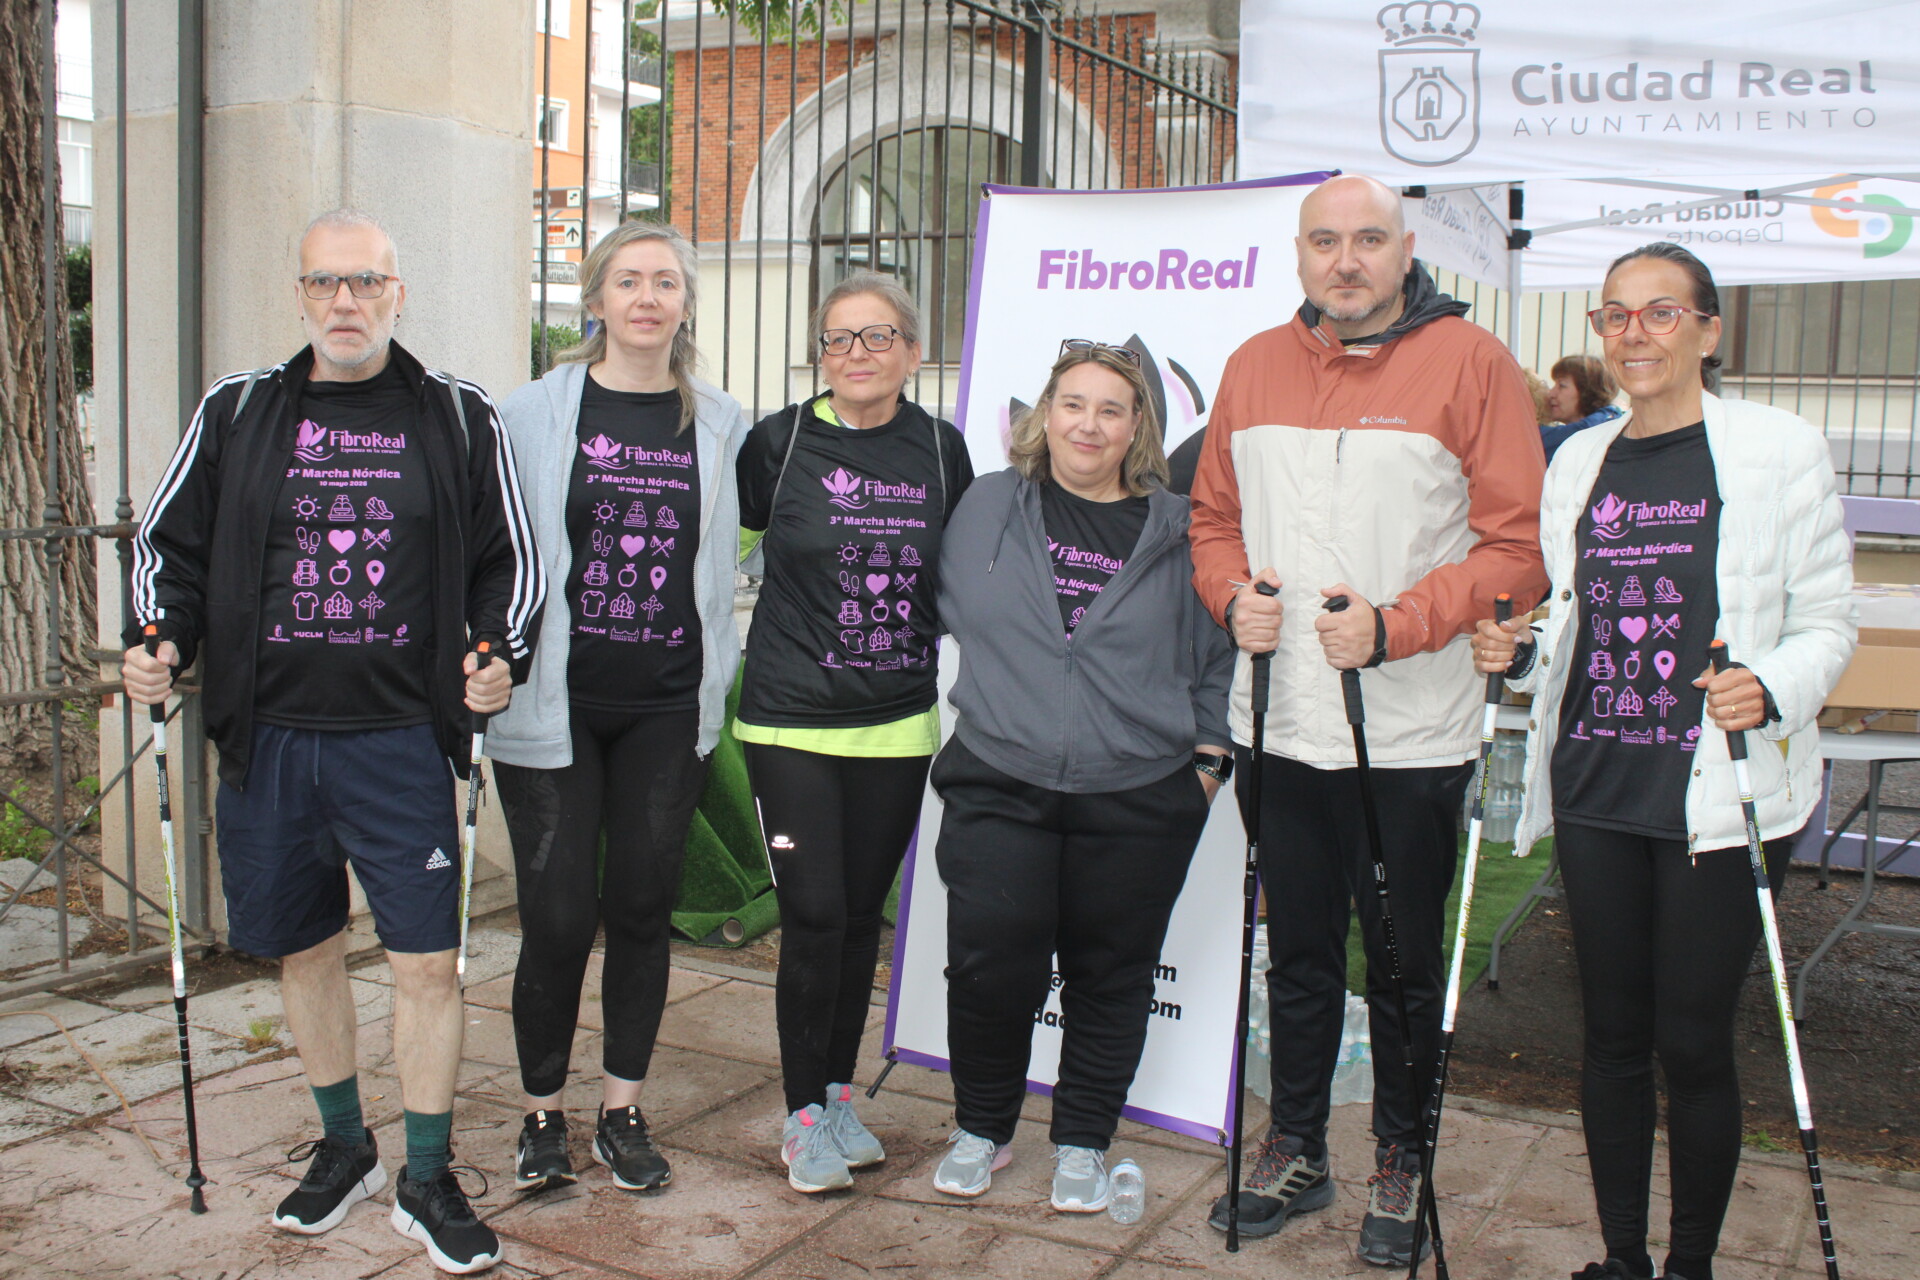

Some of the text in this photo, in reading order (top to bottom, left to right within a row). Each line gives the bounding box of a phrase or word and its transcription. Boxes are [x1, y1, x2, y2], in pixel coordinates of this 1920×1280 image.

[1511, 59, 1877, 107] Ciudad Real
[1513, 107, 1877, 137] AYUNTAMIENTO
[1036, 246, 1260, 290] FibroReal
[1368, 416, 1407, 425] Columbia
[329, 430, 406, 449] FibroReal
[624, 446, 692, 465] FibroReal
[286, 468, 401, 479] 3ª Marcha Nórdica
[586, 474, 690, 491] 3ª Marcha Nórdica
[864, 480, 926, 500] FibroReal
[1626, 498, 1706, 522] FibroReal
[830, 516, 927, 528] 3ª Marcha Nórdica
[1057, 546, 1124, 570] FibroReal
[1584, 542, 1694, 558] 3ª Marcha Nórdica
[1062, 588, 1080, 597] 2026
[583, 626, 607, 635] UCLM
[426, 859, 452, 870] adidas
